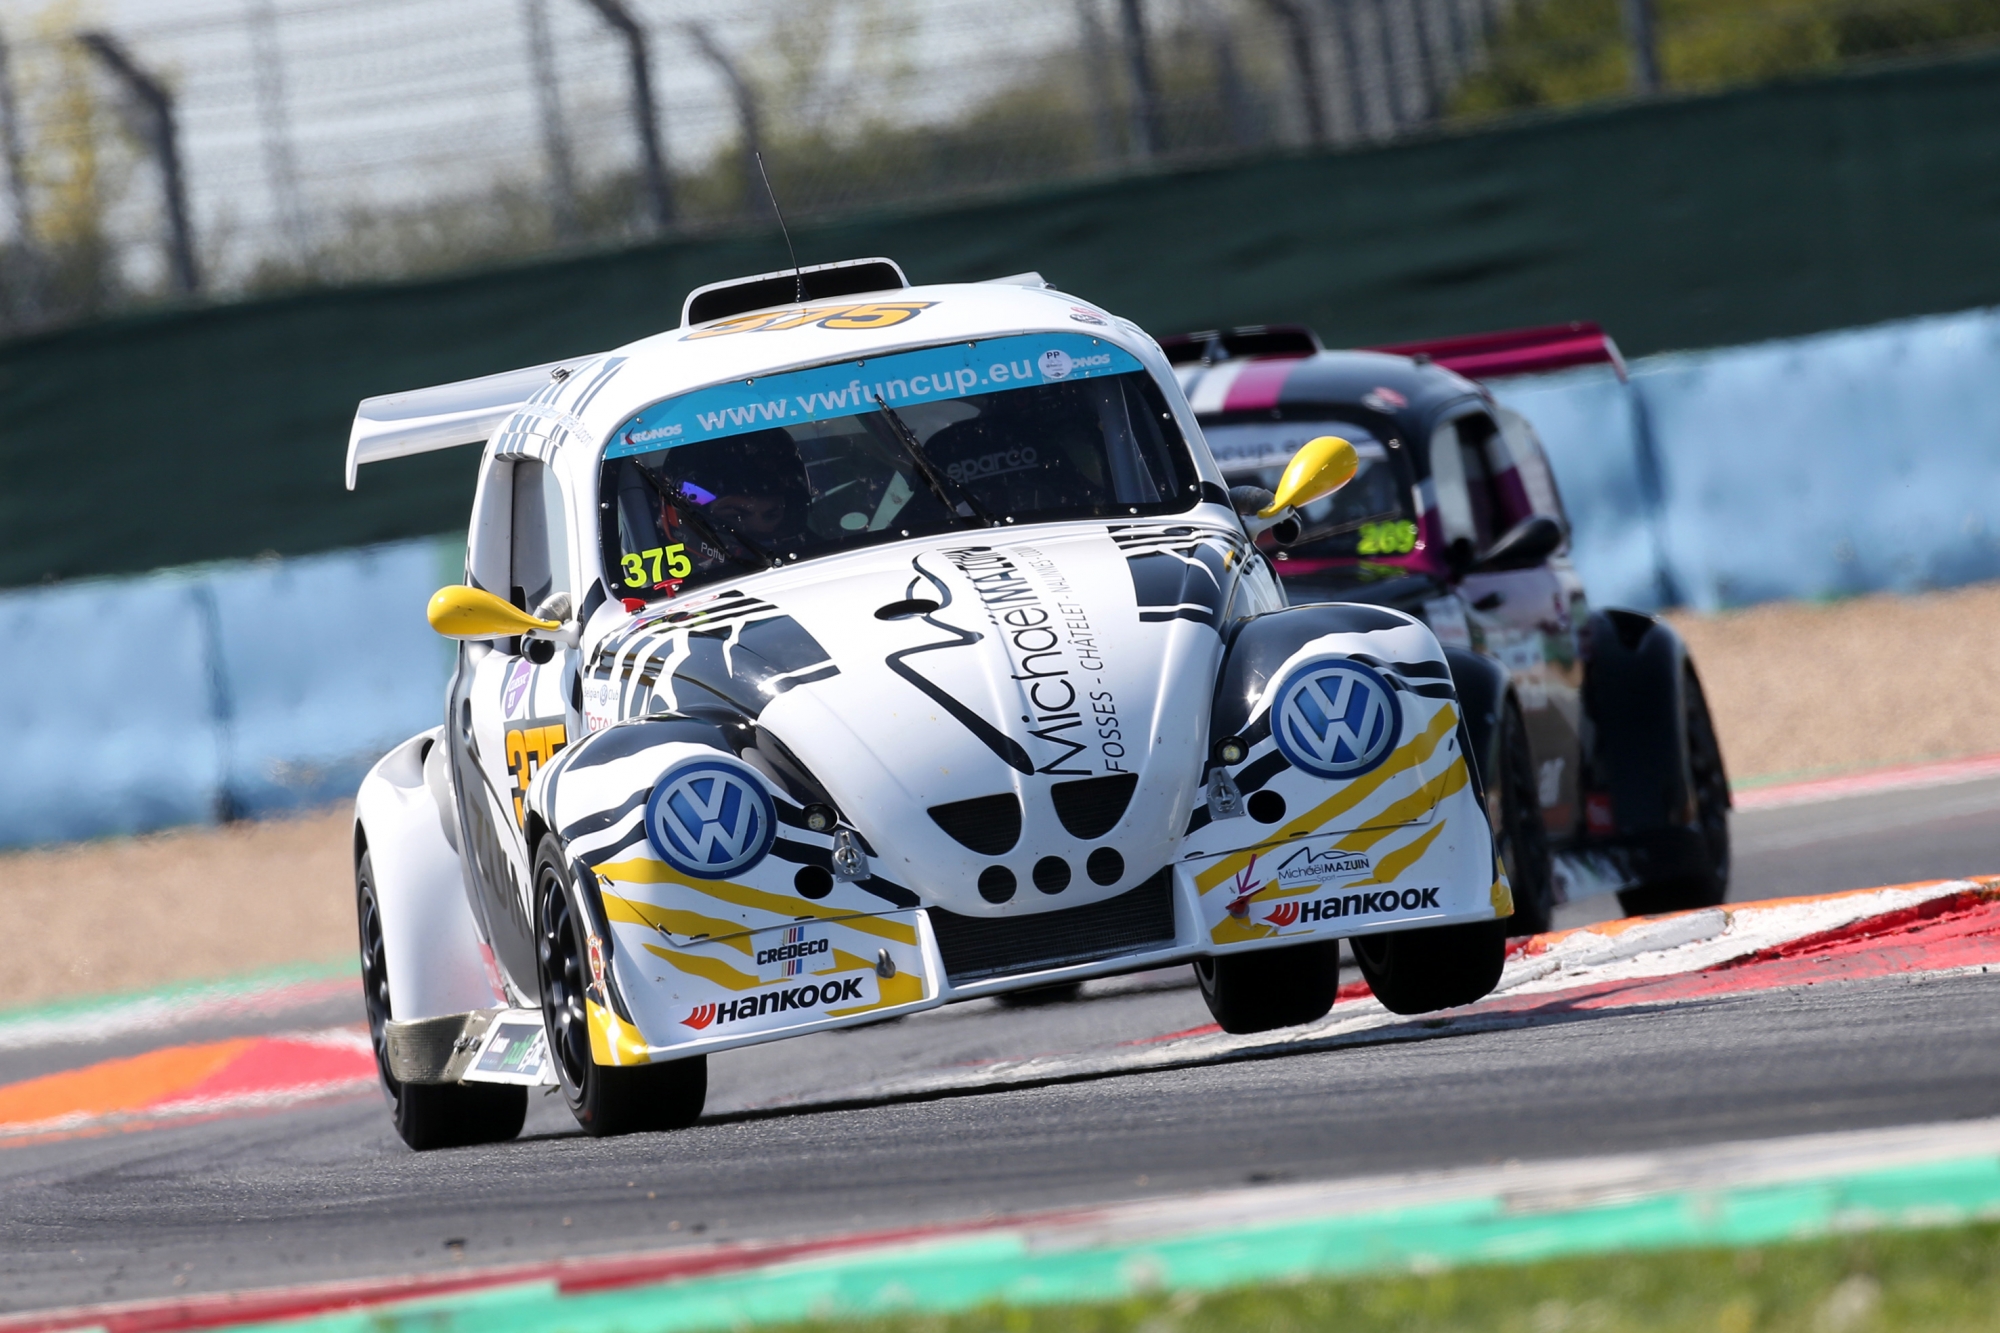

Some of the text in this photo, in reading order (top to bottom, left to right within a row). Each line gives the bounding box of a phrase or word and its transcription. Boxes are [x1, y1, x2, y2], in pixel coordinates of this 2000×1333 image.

[680, 301, 940, 341] 375
[1046, 351, 1060, 360] PP
[1072, 354, 1111, 369] ONOS
[696, 358, 1034, 432] www.vwfuncup.eu
[620, 424, 682, 445] KRONOS
[947, 447, 1037, 483] sparco
[621, 543, 692, 588] 375
[1057, 602, 1104, 671] CHÂTELET
[1089, 691, 1129, 773] FOSSES
[1316, 874, 1337, 884] Sport
[756, 938, 829, 966] CREDECO
